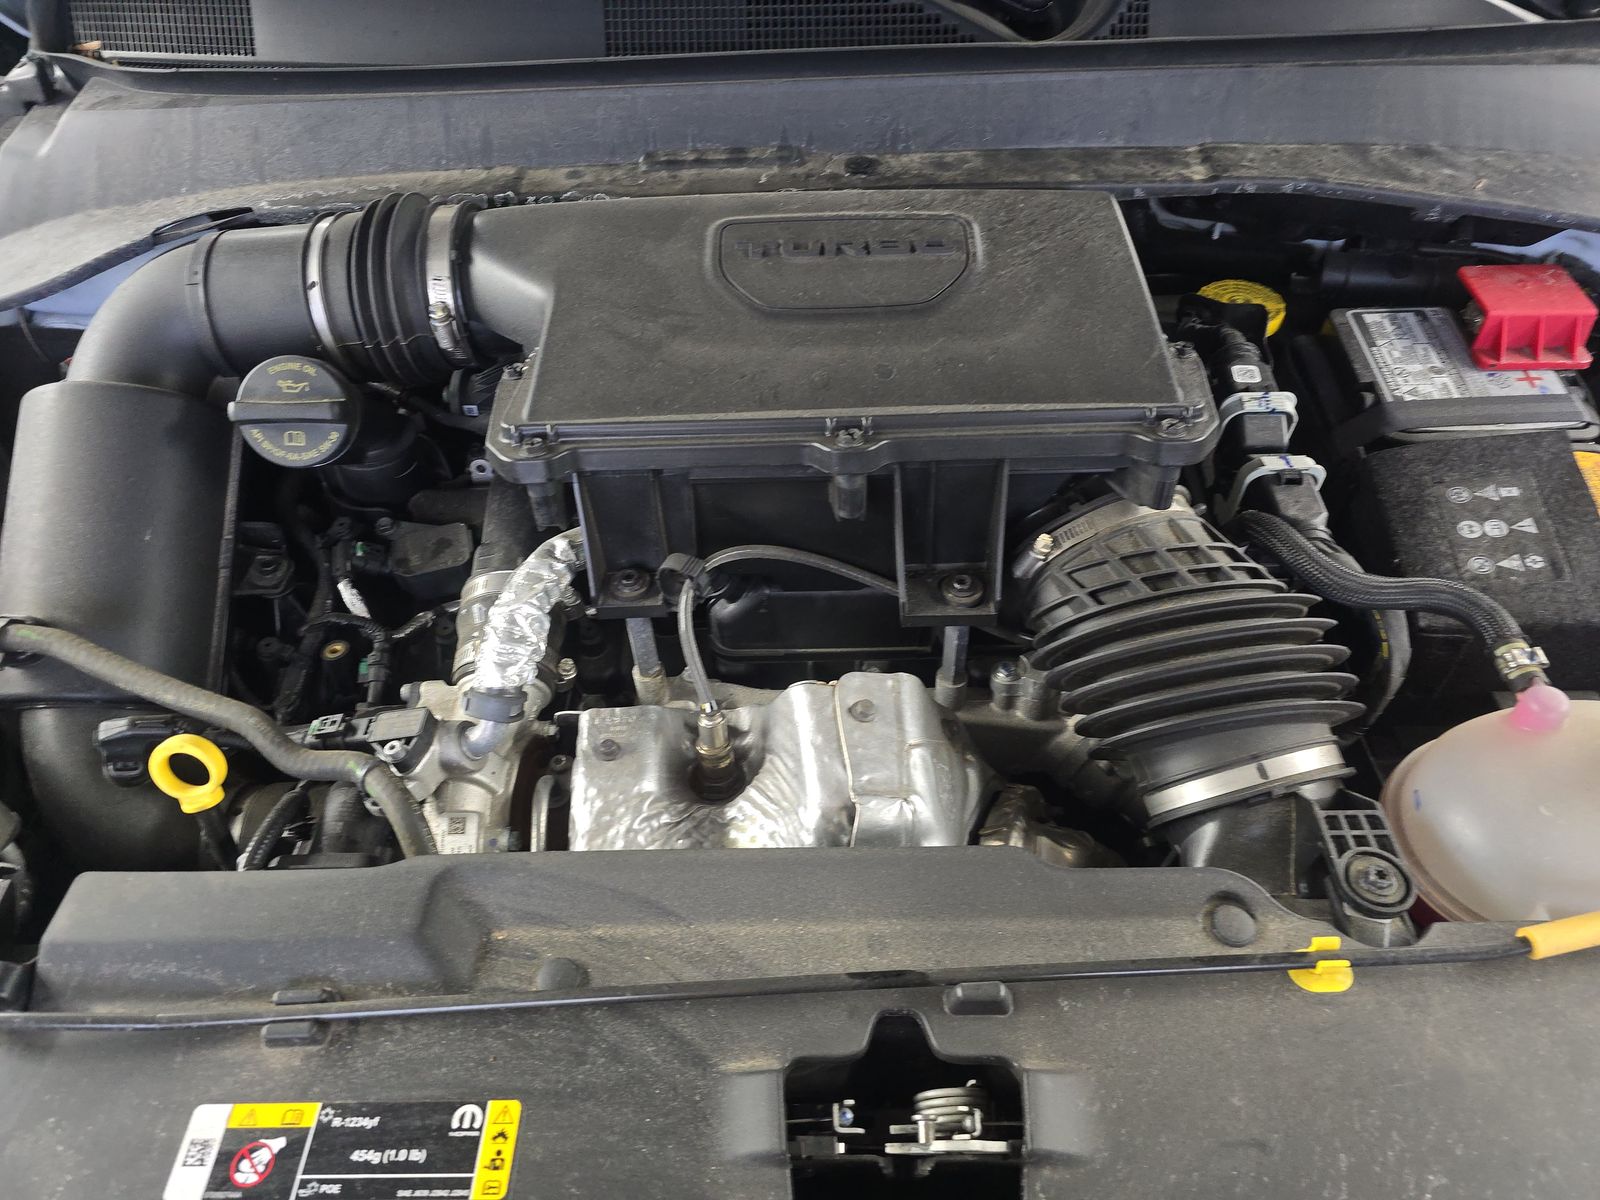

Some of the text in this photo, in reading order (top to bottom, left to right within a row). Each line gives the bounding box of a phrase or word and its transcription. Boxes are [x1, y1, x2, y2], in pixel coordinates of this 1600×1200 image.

[266, 362, 318, 377] ENGINE OIL
[349, 1149, 382, 1164] 454g
[318, 1183, 342, 1195] POE
